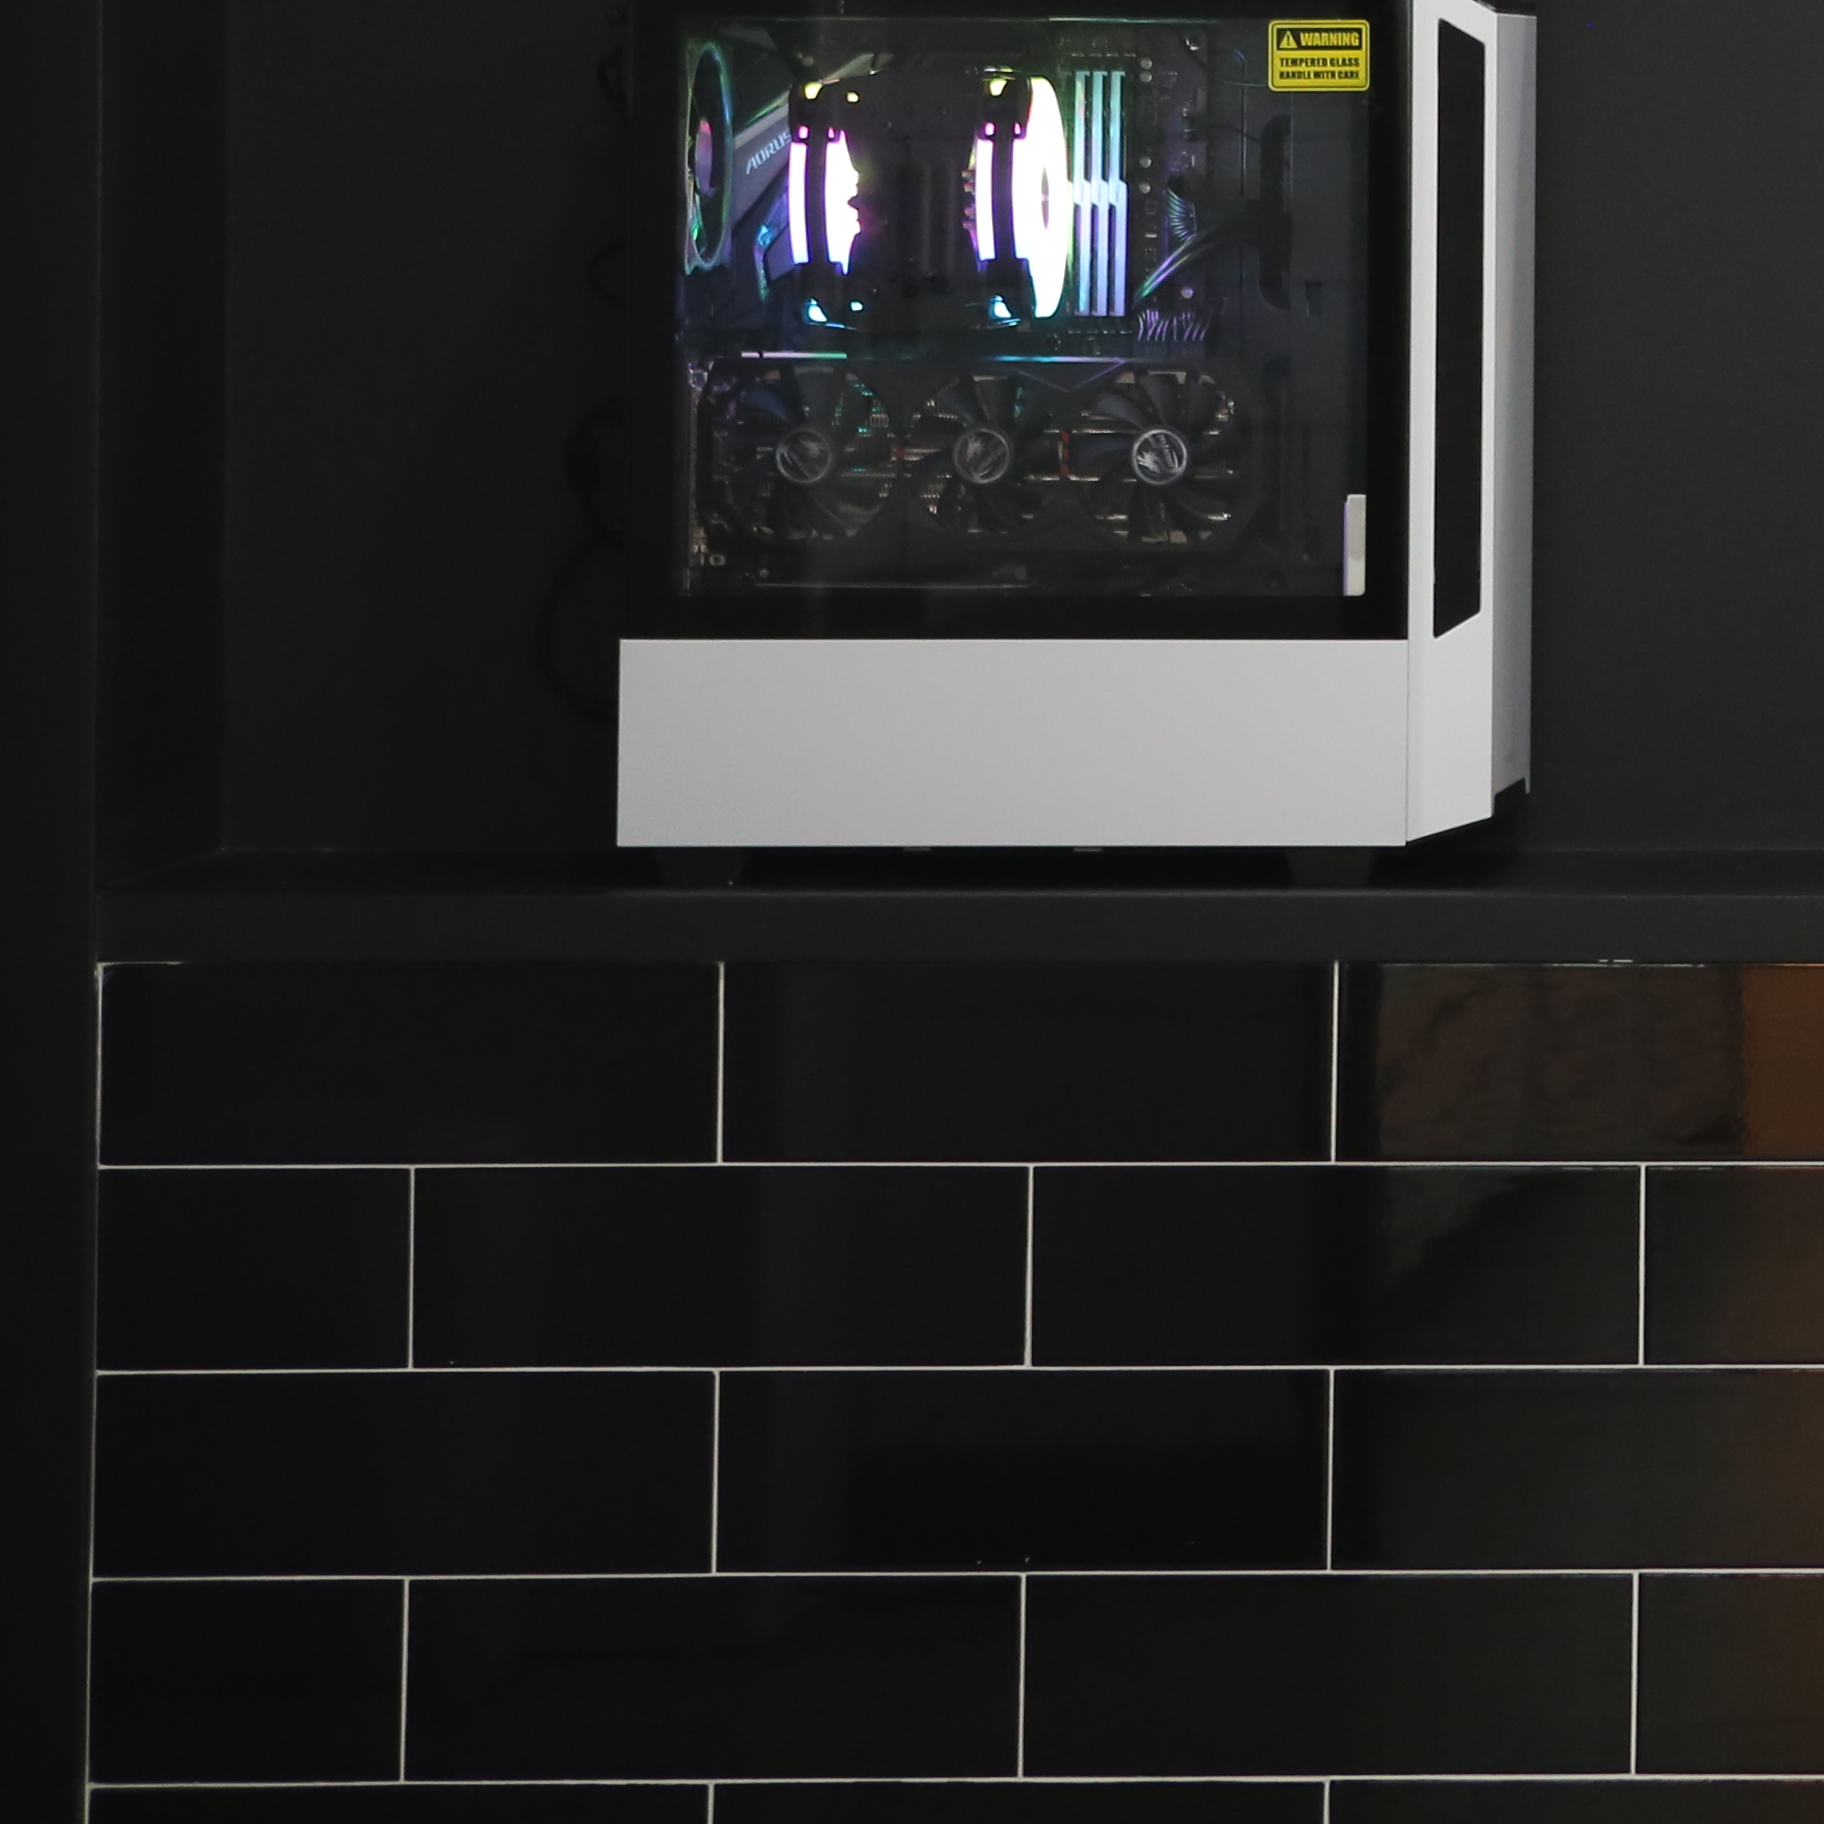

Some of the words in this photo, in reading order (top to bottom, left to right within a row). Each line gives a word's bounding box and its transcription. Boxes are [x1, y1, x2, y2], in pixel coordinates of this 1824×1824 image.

[1300, 31, 1360, 47] WARNING
[1280, 57, 1328, 67] TEMPERED
[1329, 57, 1360, 67] GLASS
